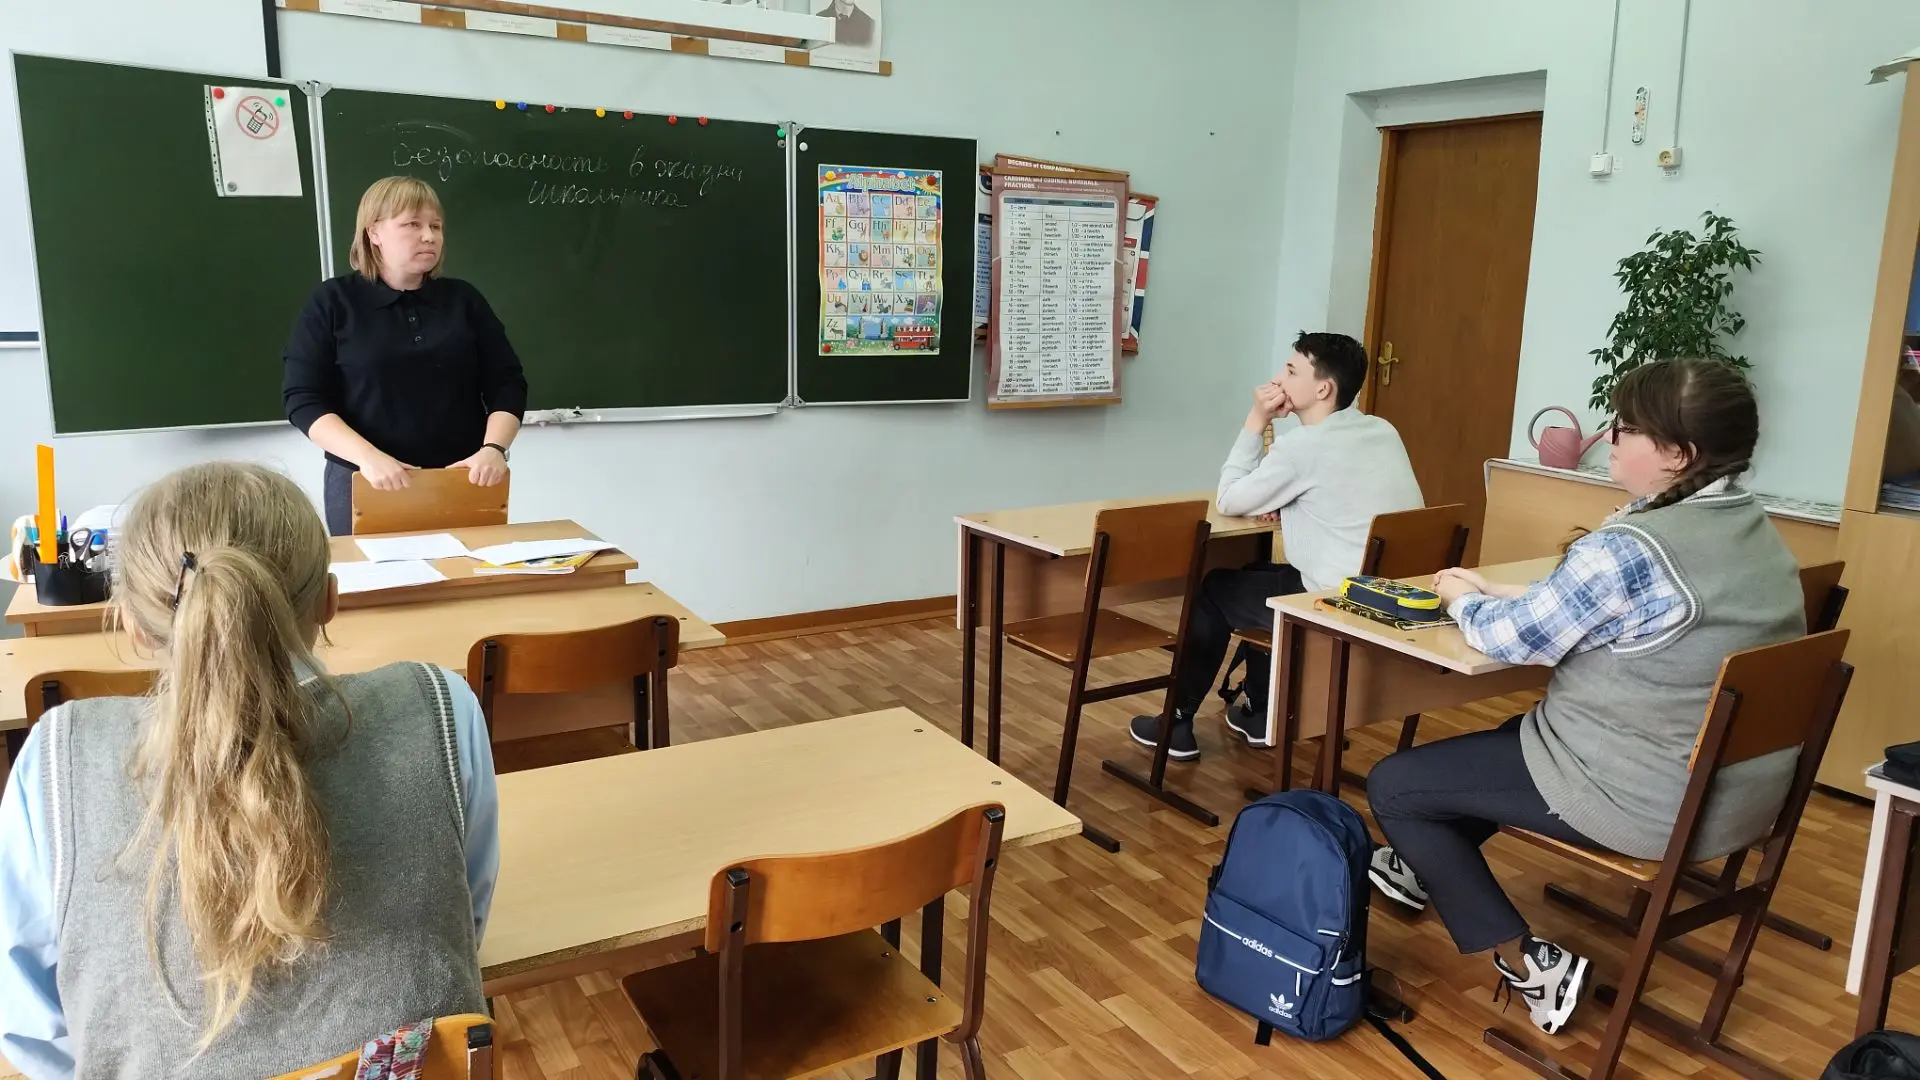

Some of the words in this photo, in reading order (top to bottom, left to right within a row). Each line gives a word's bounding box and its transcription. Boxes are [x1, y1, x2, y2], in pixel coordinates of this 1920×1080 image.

[629, 144, 644, 178] в
[846, 173, 916, 192] Alphabet
[1242, 937, 1273, 958] adidas
[1268, 1005, 1293, 1019] adidas
